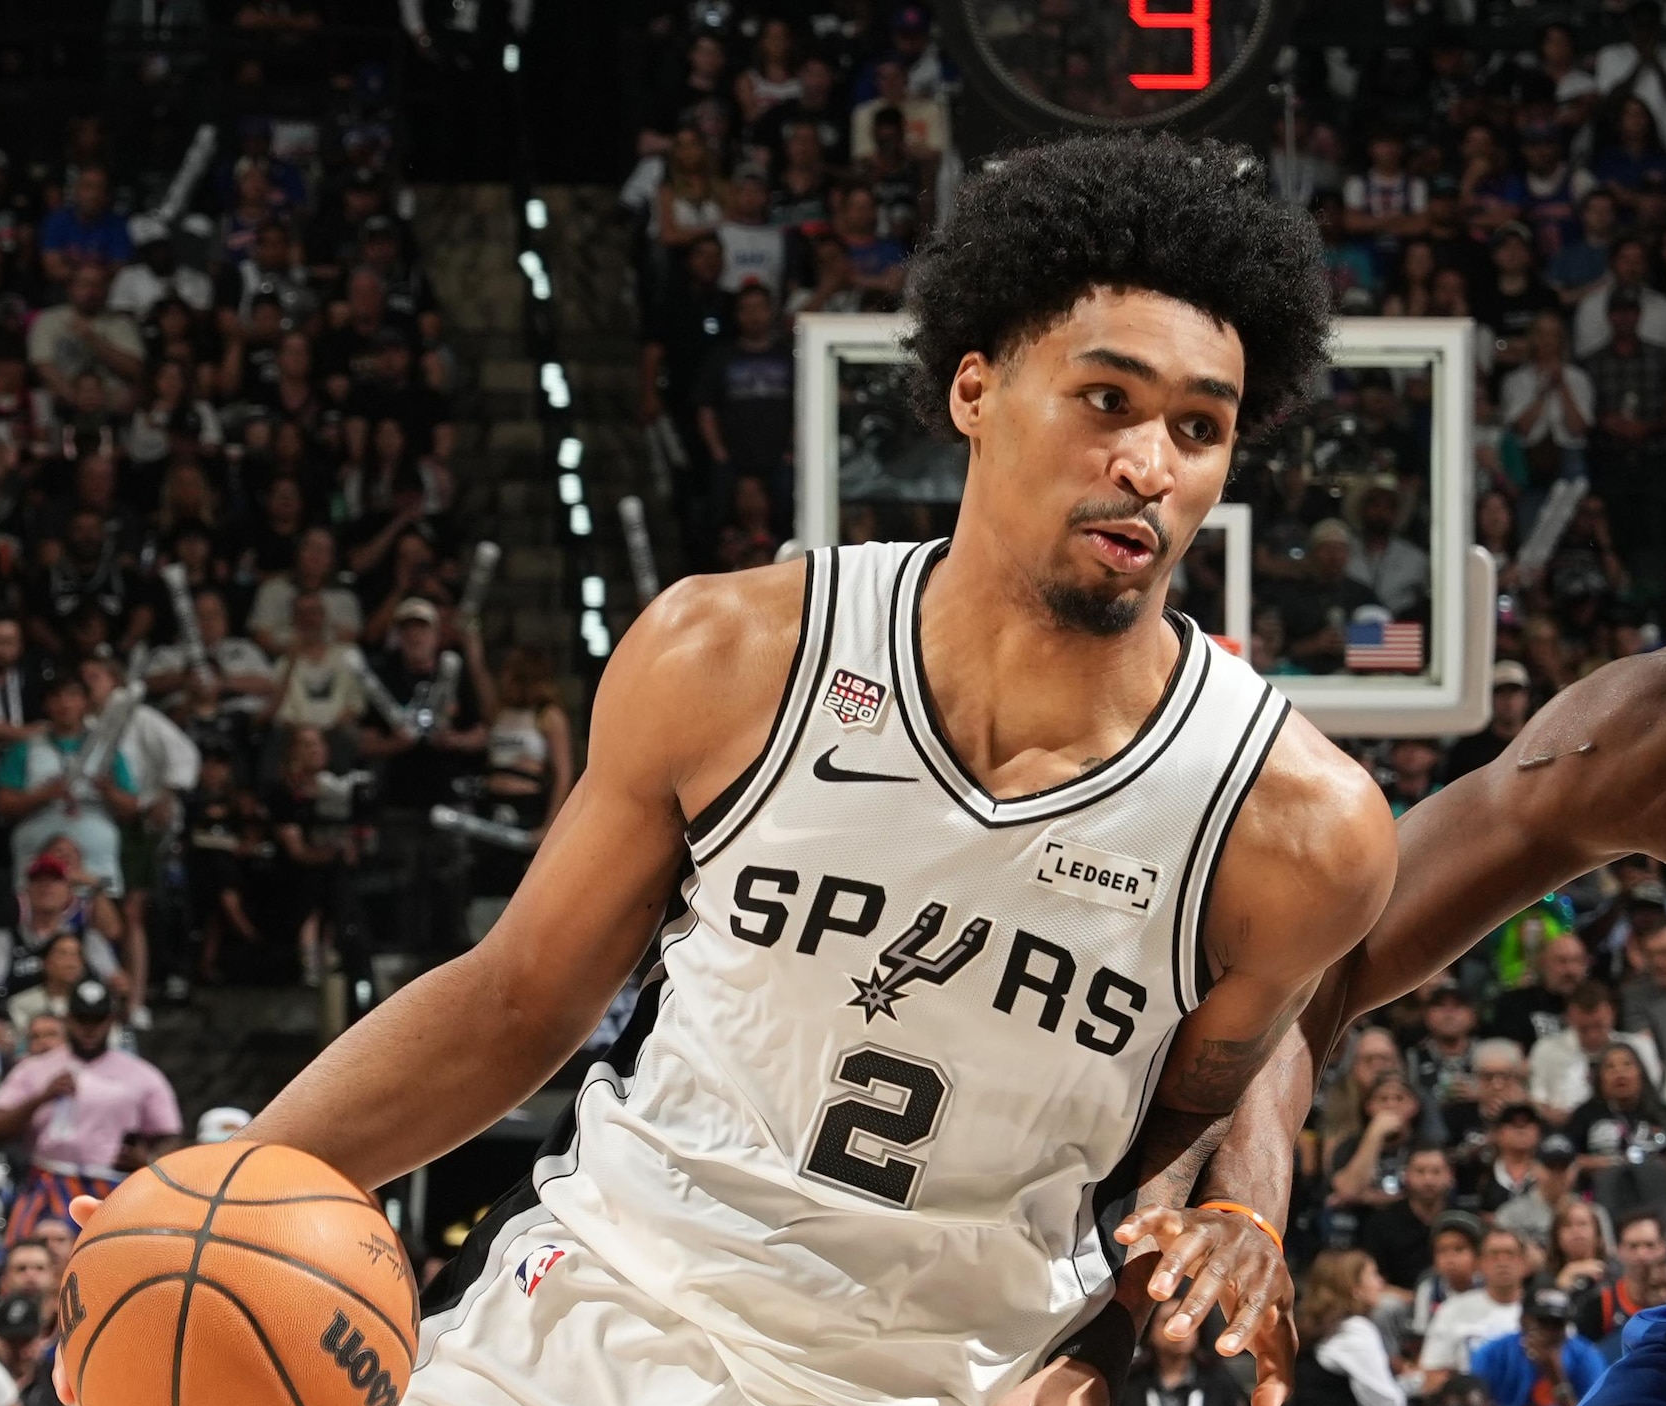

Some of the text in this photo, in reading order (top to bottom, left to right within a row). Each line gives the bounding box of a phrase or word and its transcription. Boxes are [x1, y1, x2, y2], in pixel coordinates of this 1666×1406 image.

[836, 672, 880, 700] USA
[824, 692, 876, 723] 250
[1054, 857, 1139, 895] LEDGER
[730, 865, 1148, 1057] SPURS
[798, 1041, 954, 1210] 2
